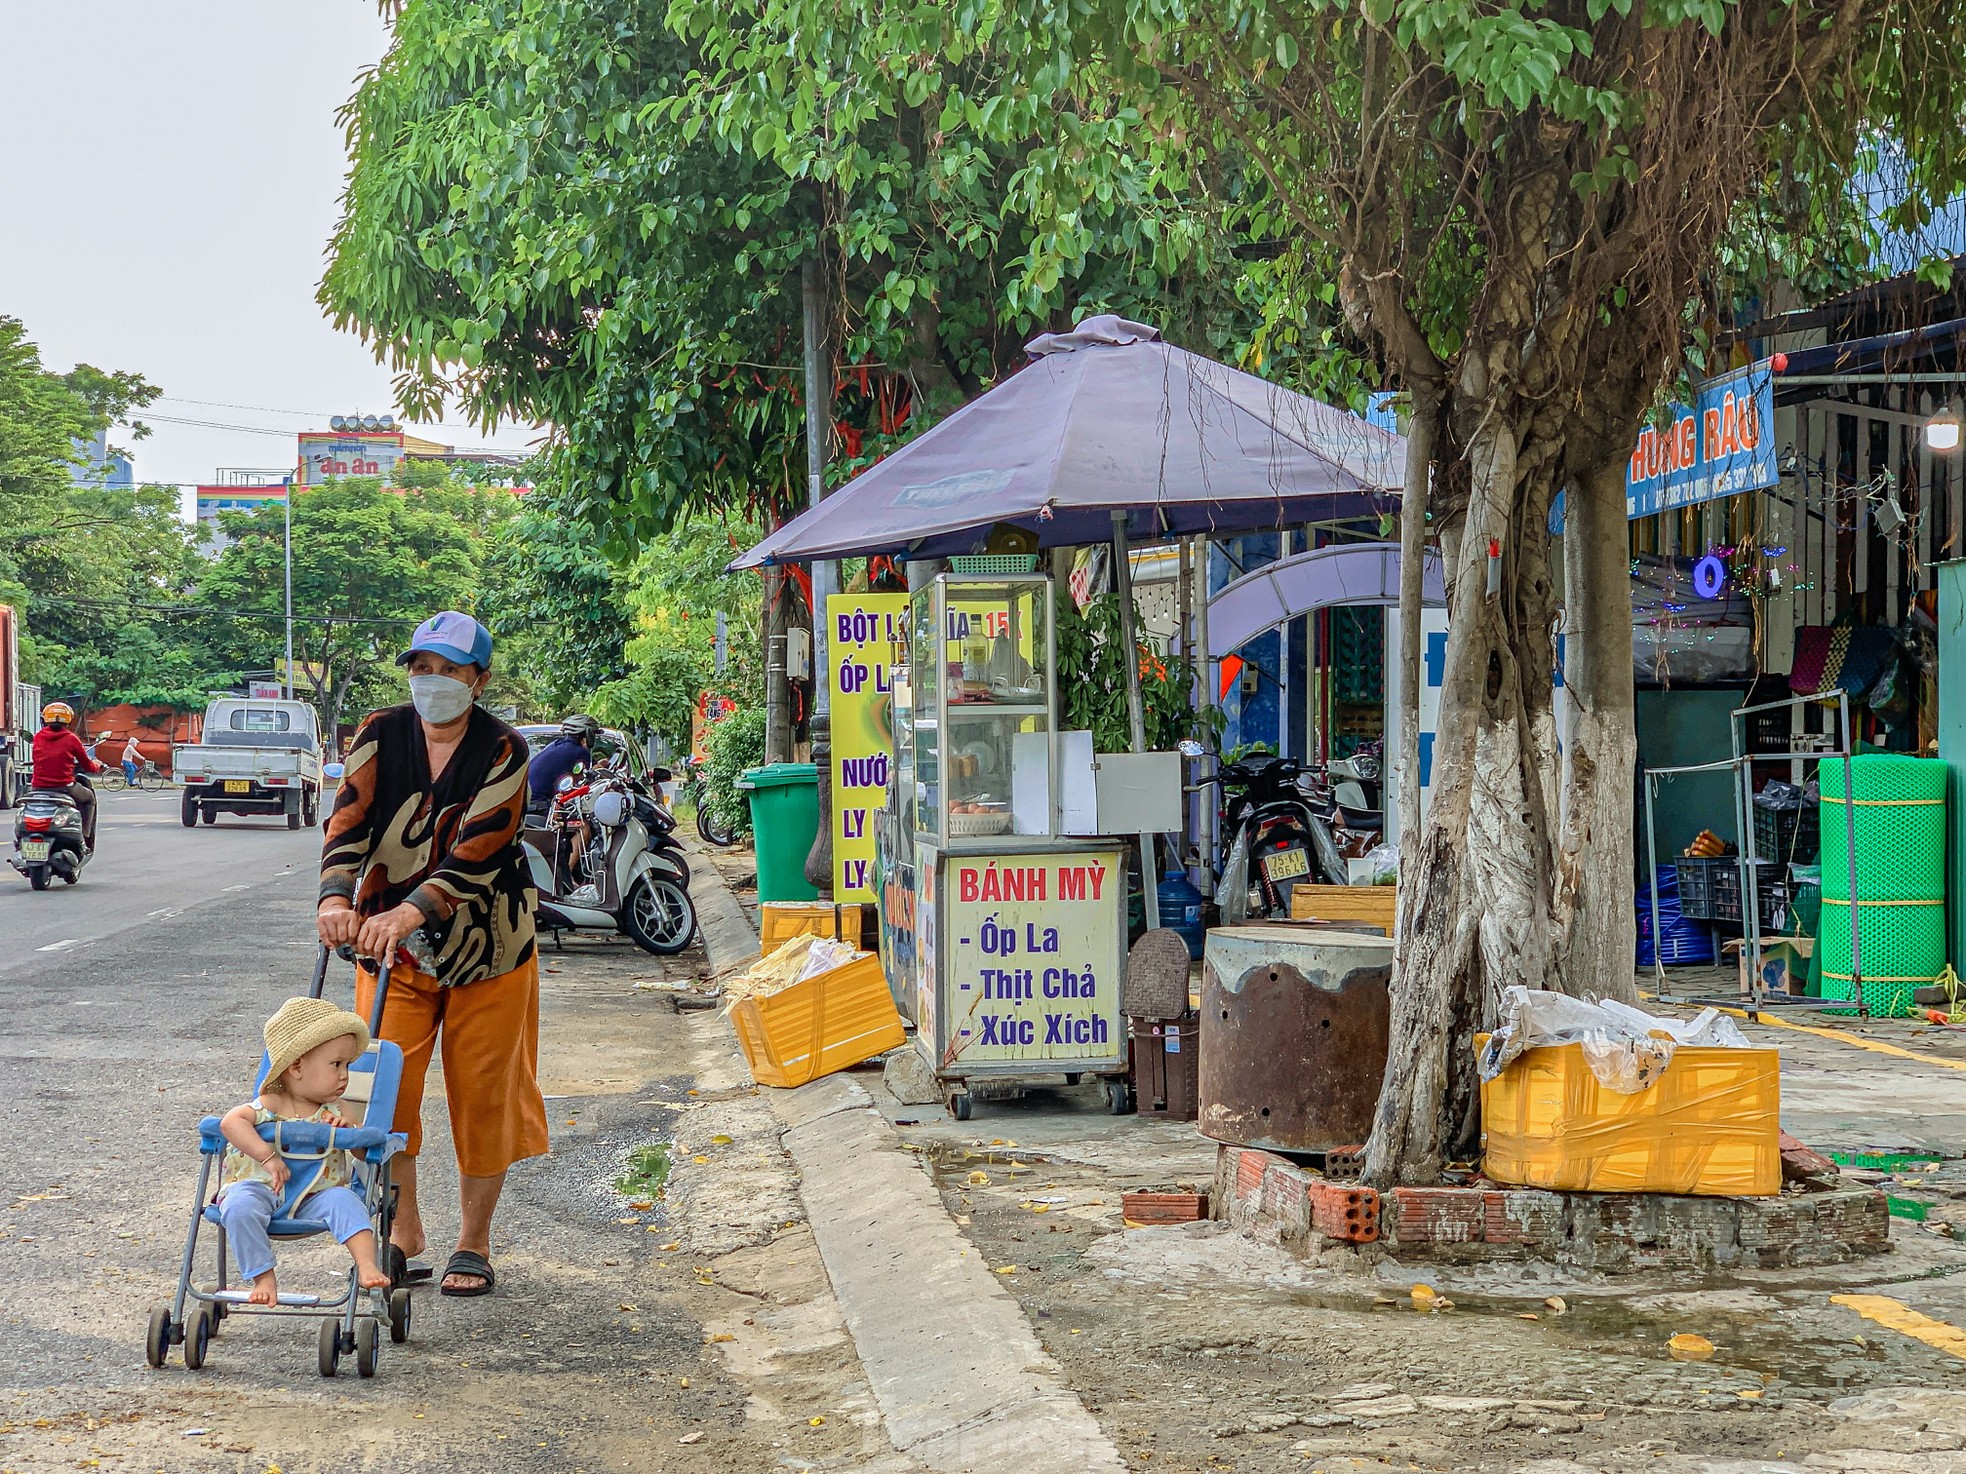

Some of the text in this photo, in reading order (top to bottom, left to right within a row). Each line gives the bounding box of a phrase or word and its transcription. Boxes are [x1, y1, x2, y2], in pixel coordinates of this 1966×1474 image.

[837, 607, 879, 649] BỘT
[946, 606, 970, 641] ĨA
[839, 654, 868, 693] ỐP
[842, 752, 888, 788] NƯỚ
[843, 809, 866, 838] LY
[844, 860, 867, 889] LY
[1271, 851, 1300, 867] 75-K1
[960, 861, 1047, 902] BÁNH
[1058, 859, 1107, 901] MỲ
[980, 912, 1016, 957] Ốp
[1026, 922, 1059, 953] La
[980, 969, 1033, 1006] Thịt
[1042, 963, 1096, 999] Chả
[981, 1014, 1035, 1046] Xúc
[1044, 1013, 1108, 1045] Xích
